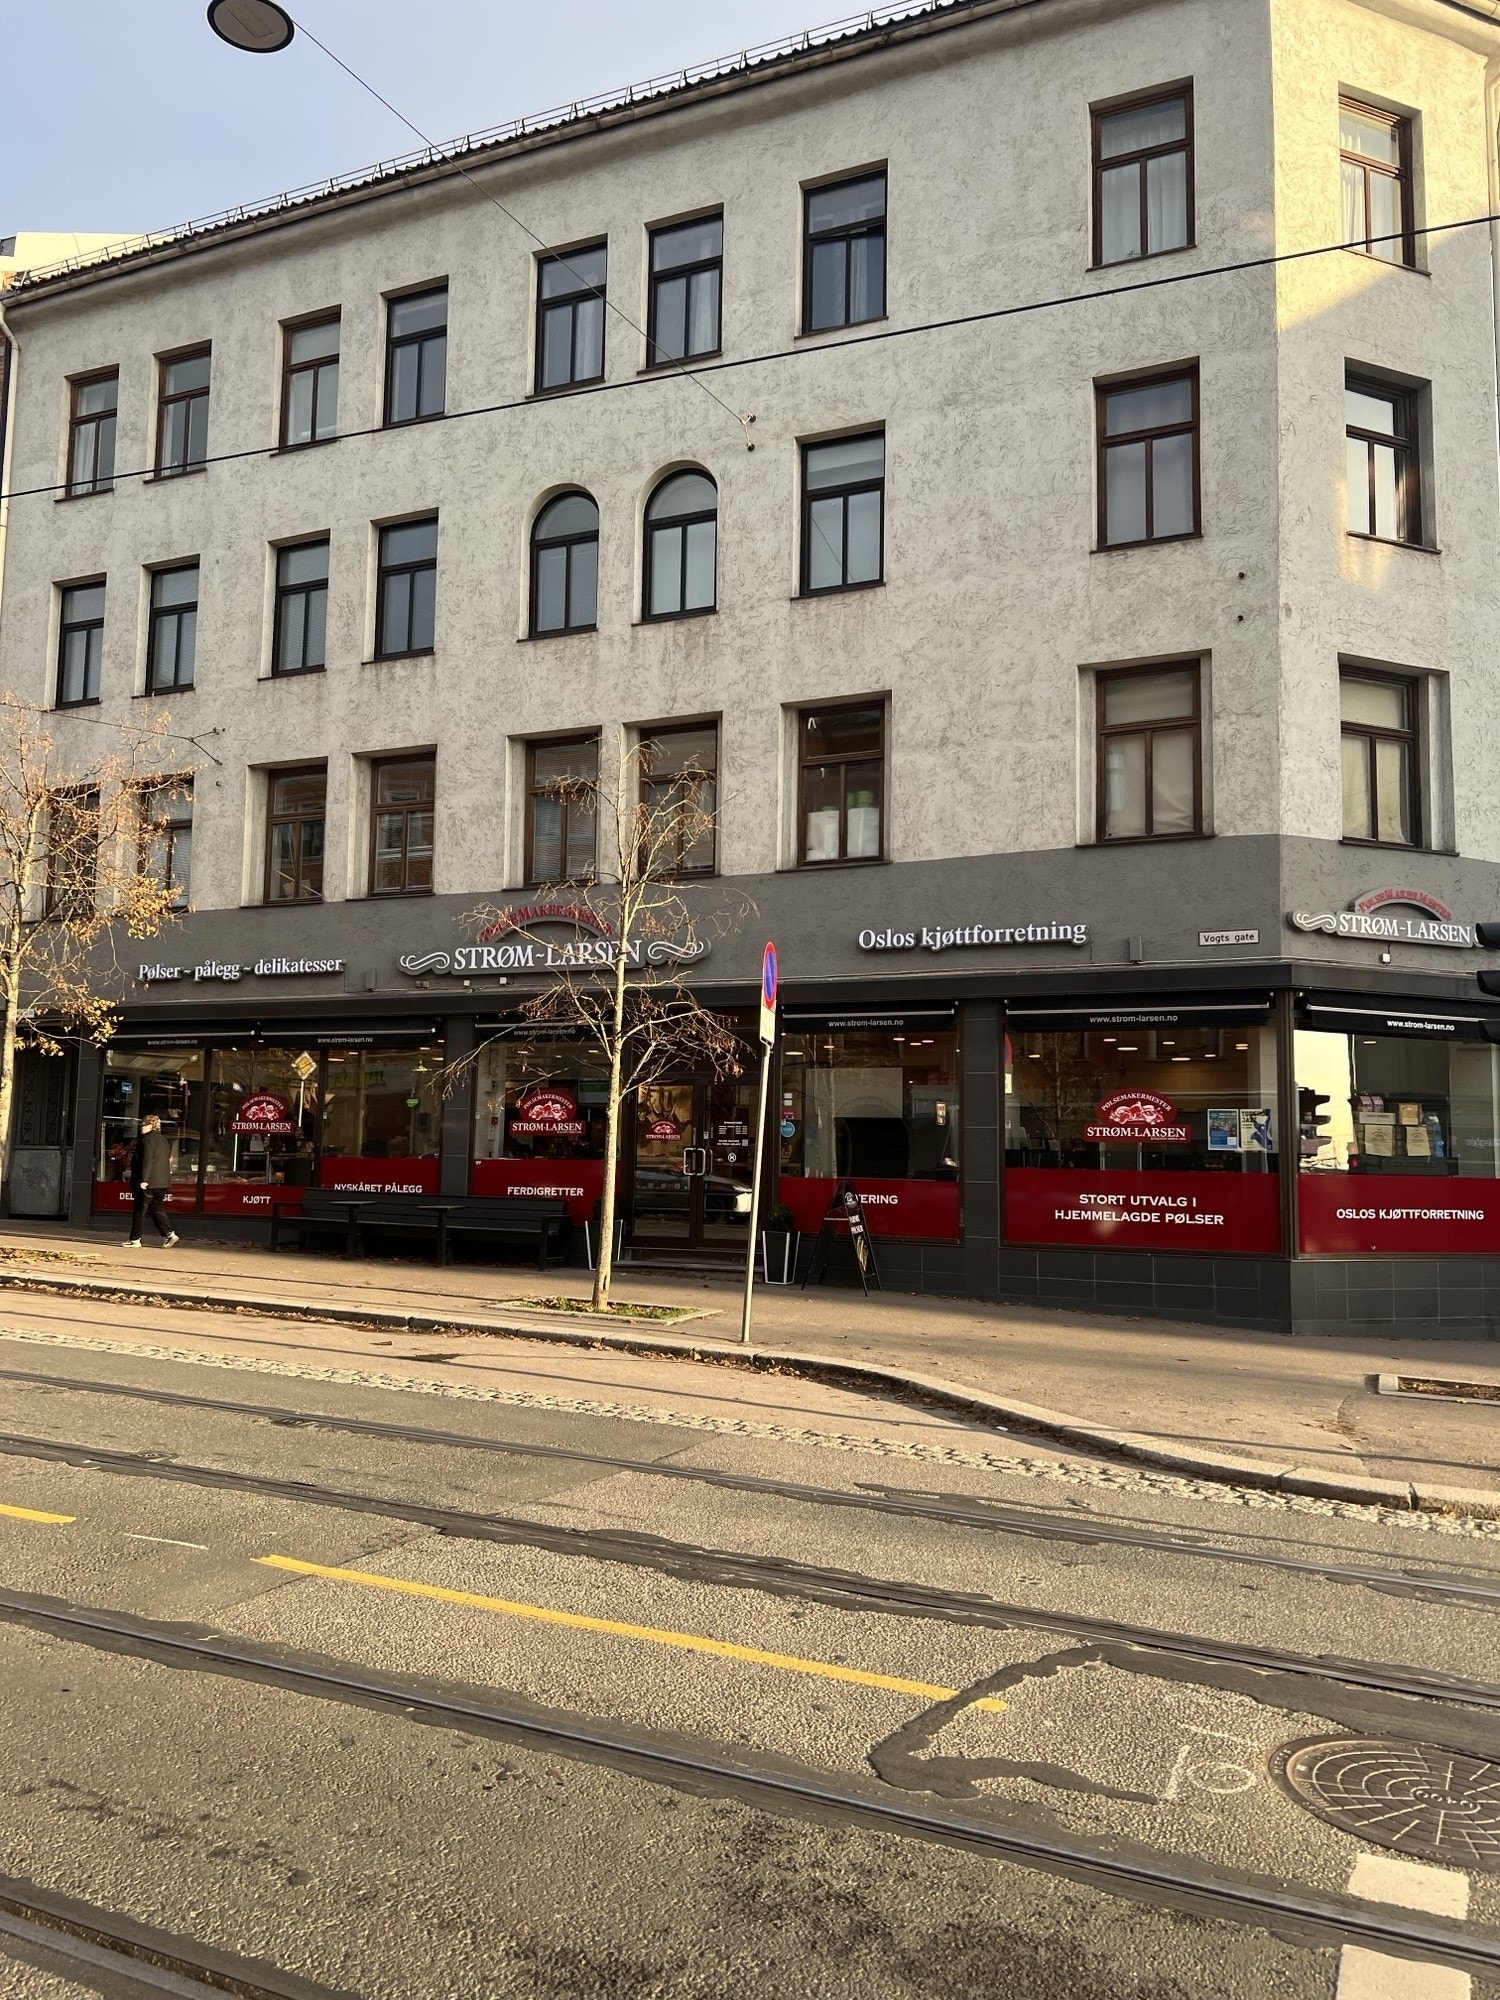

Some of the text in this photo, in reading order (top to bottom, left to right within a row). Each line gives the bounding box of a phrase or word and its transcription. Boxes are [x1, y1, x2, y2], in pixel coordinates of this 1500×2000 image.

[858, 921, 1086, 949] Oslos kjøttforretning
[1203, 931, 1255, 943] Vogts gate
[139, 963, 180, 979] Pølser
[194, 959, 240, 981] pålegg
[254, 957, 342, 974] delikatesser
[828, 1018, 904, 1028] www.strom-larsen.no
[1089, 1014, 1178, 1023] www.strom-larsen.no
[1387, 1019, 1455, 1031] www.strom-larsen.no
[1101, 1092, 1173, 1112] PØLSEMAKERMESTER
[1087, 1126, 1187, 1137] STRØM-LARSEN
[334, 1181, 423, 1193] NYSKÅRET PÅLEGG
[507, 1186, 584, 1196] FERDIGRETTER
[242, 1195, 271, 1205] KJØTT
[1079, 1194, 1126, 1205] STORT
[1130, 1195, 1188, 1207] UTVALG
[1054, 1209, 1224, 1225] HJEMMELAGDE PØLSER
[1336, 1208, 1484, 1220] OSLOS KJØTTFORRETNING
